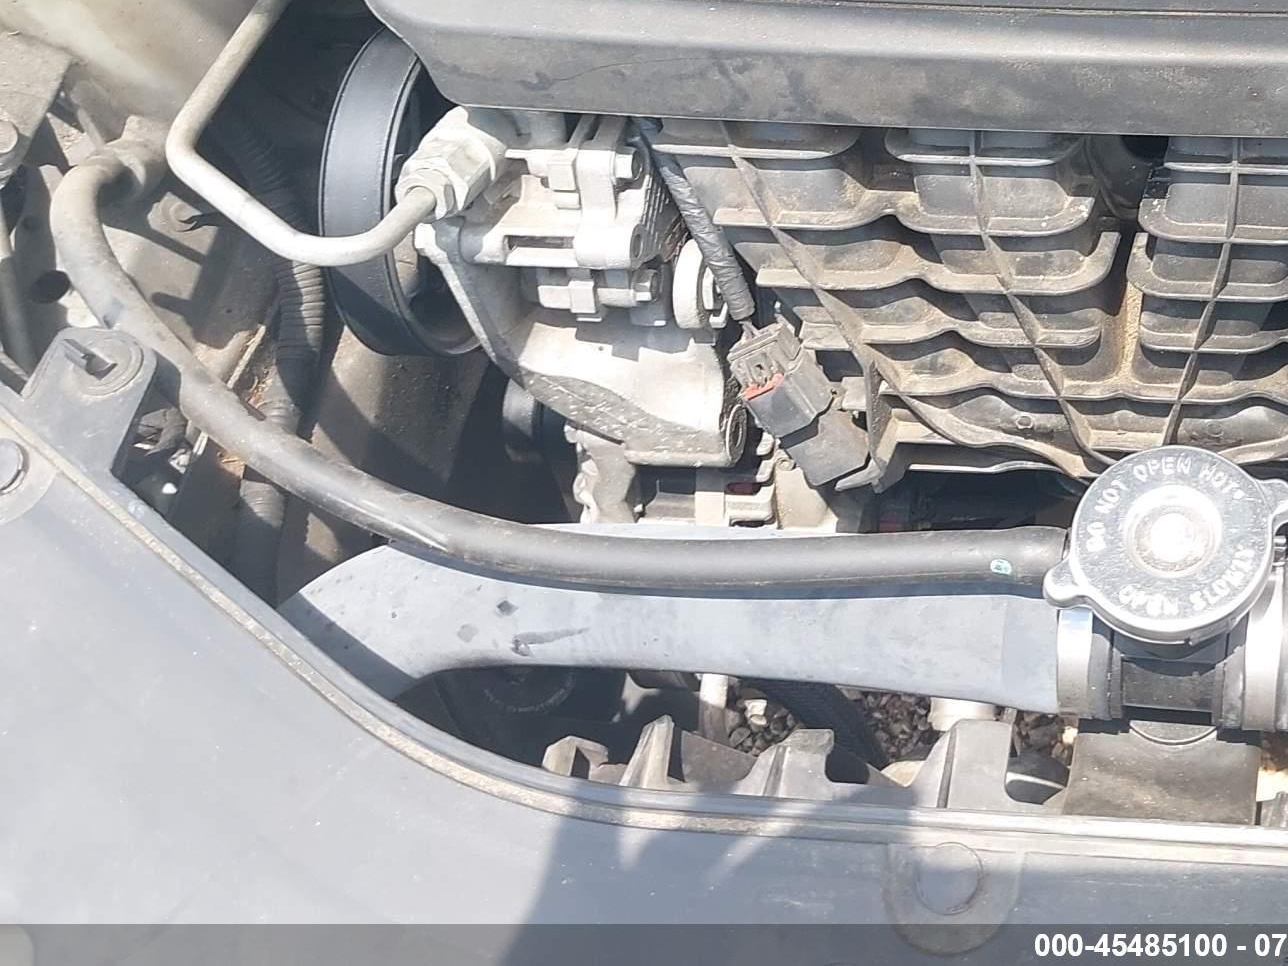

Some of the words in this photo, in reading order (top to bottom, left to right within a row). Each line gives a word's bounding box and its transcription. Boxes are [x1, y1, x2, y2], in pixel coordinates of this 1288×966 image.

[1132, 455, 1193, 483] OPEN
[1094, 479, 1130, 515] NOT
[1085, 520, 1107, 553] DO
